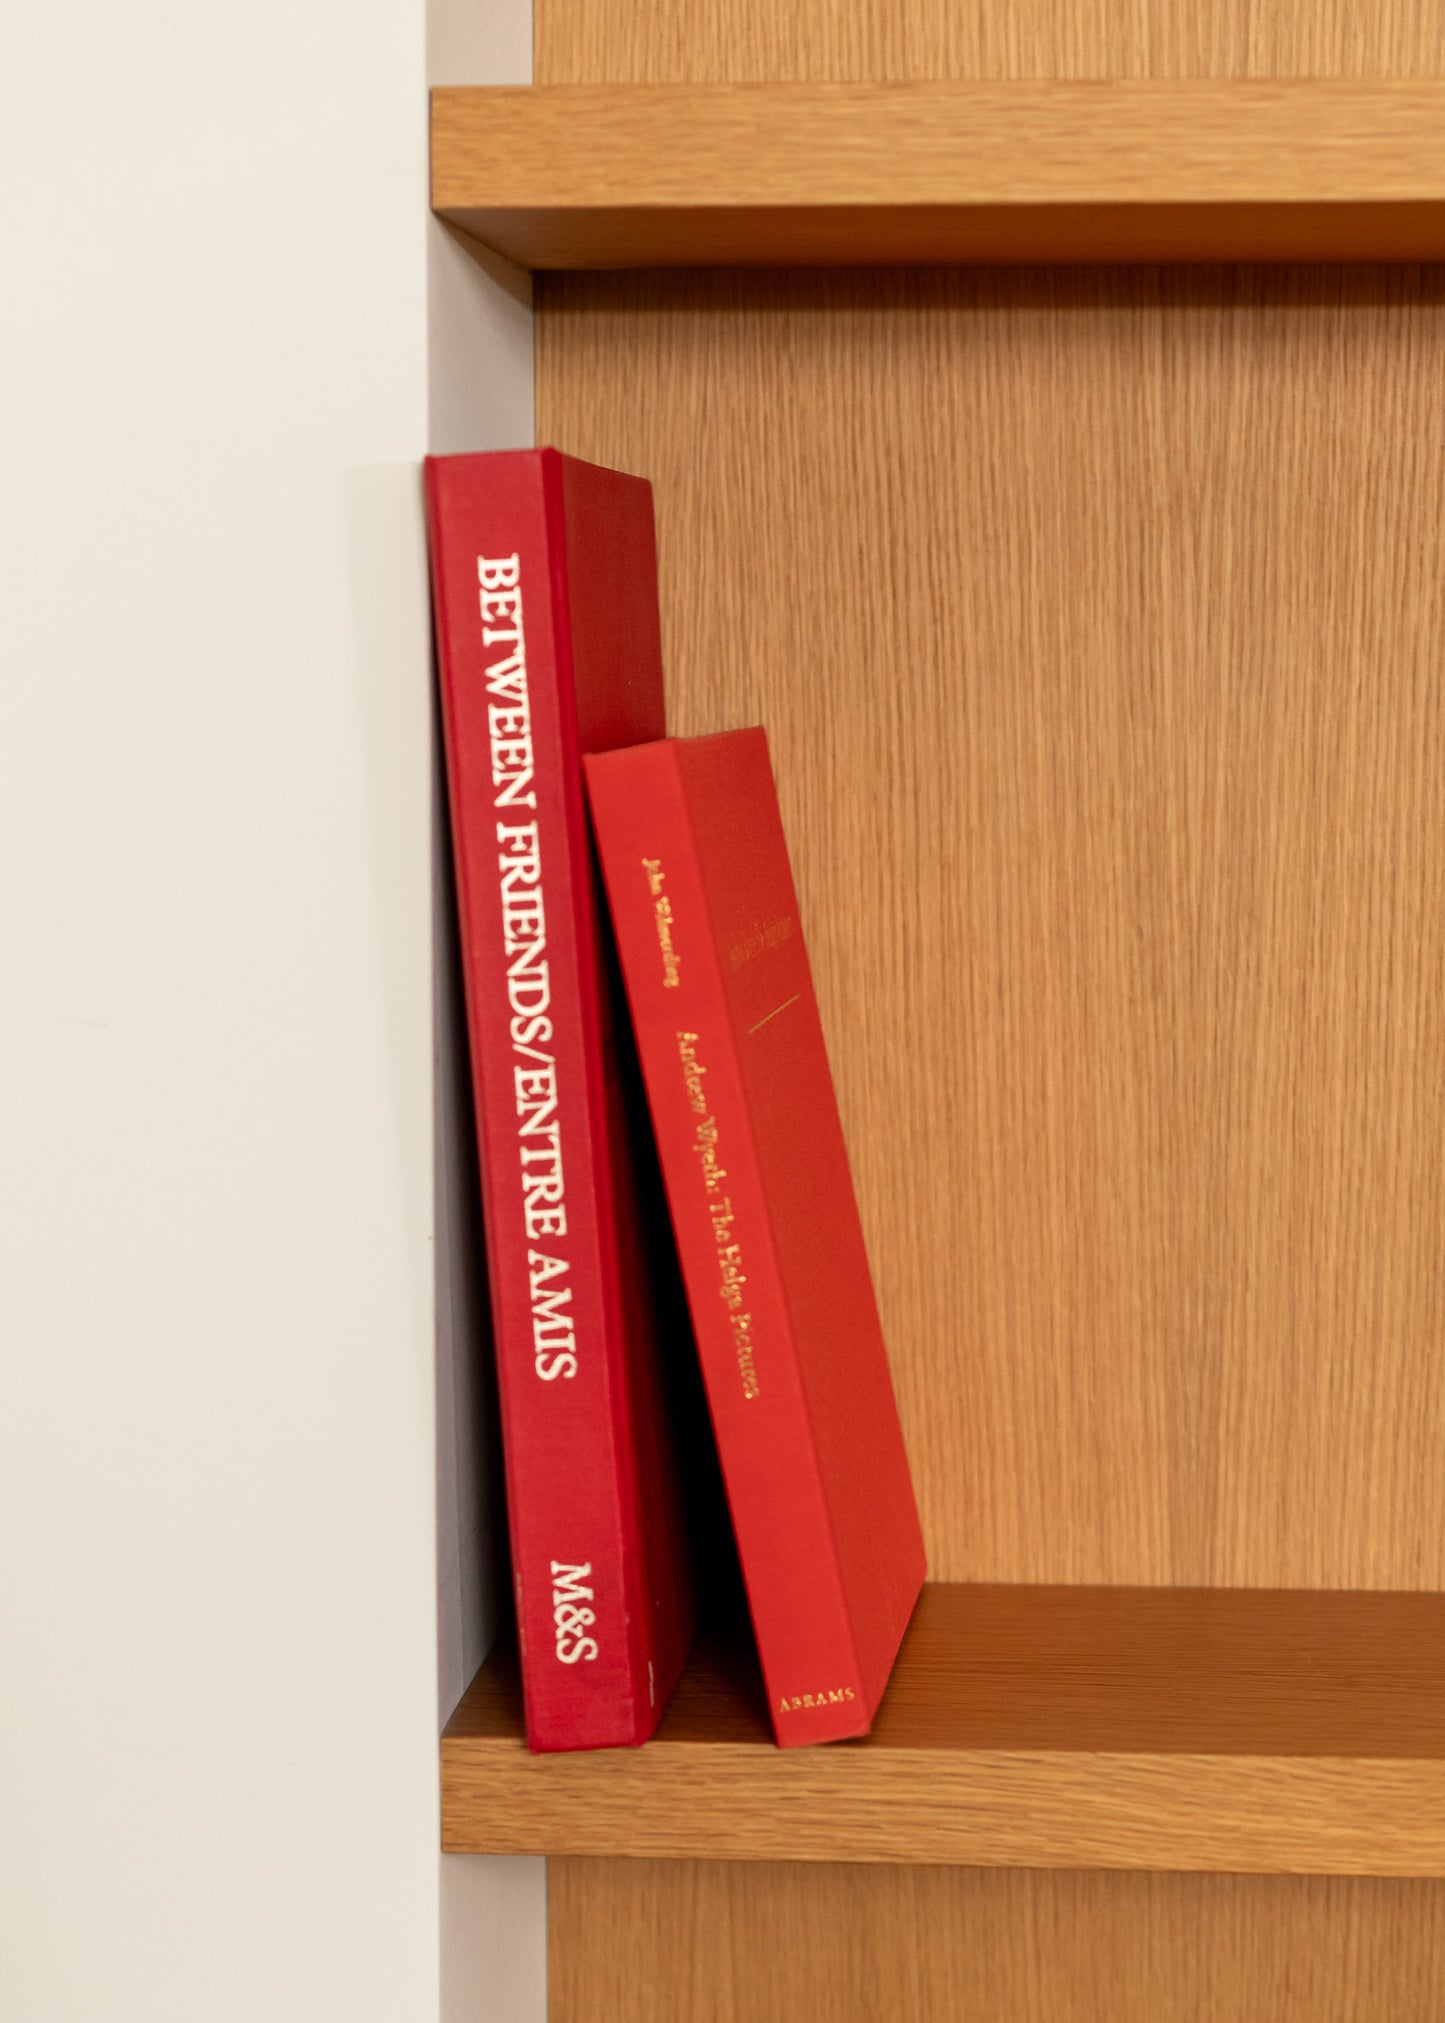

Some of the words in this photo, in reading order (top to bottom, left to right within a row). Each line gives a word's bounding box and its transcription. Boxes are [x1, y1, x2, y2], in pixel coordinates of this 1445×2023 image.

[477, 552, 538, 809] BETWEEN
[496, 820, 568, 1239] FRIENDS/ENTRE
[676, 1031, 707, 1114] Andrew
[709, 1197, 734, 1242] The
[527, 1248, 578, 1381] AMIS
[717, 1244, 747, 1310] Helga
[730, 1312, 760, 1399] Pictures
[551, 1560, 599, 1664] M&S
[780, 1687, 855, 1713] ABRAMS
